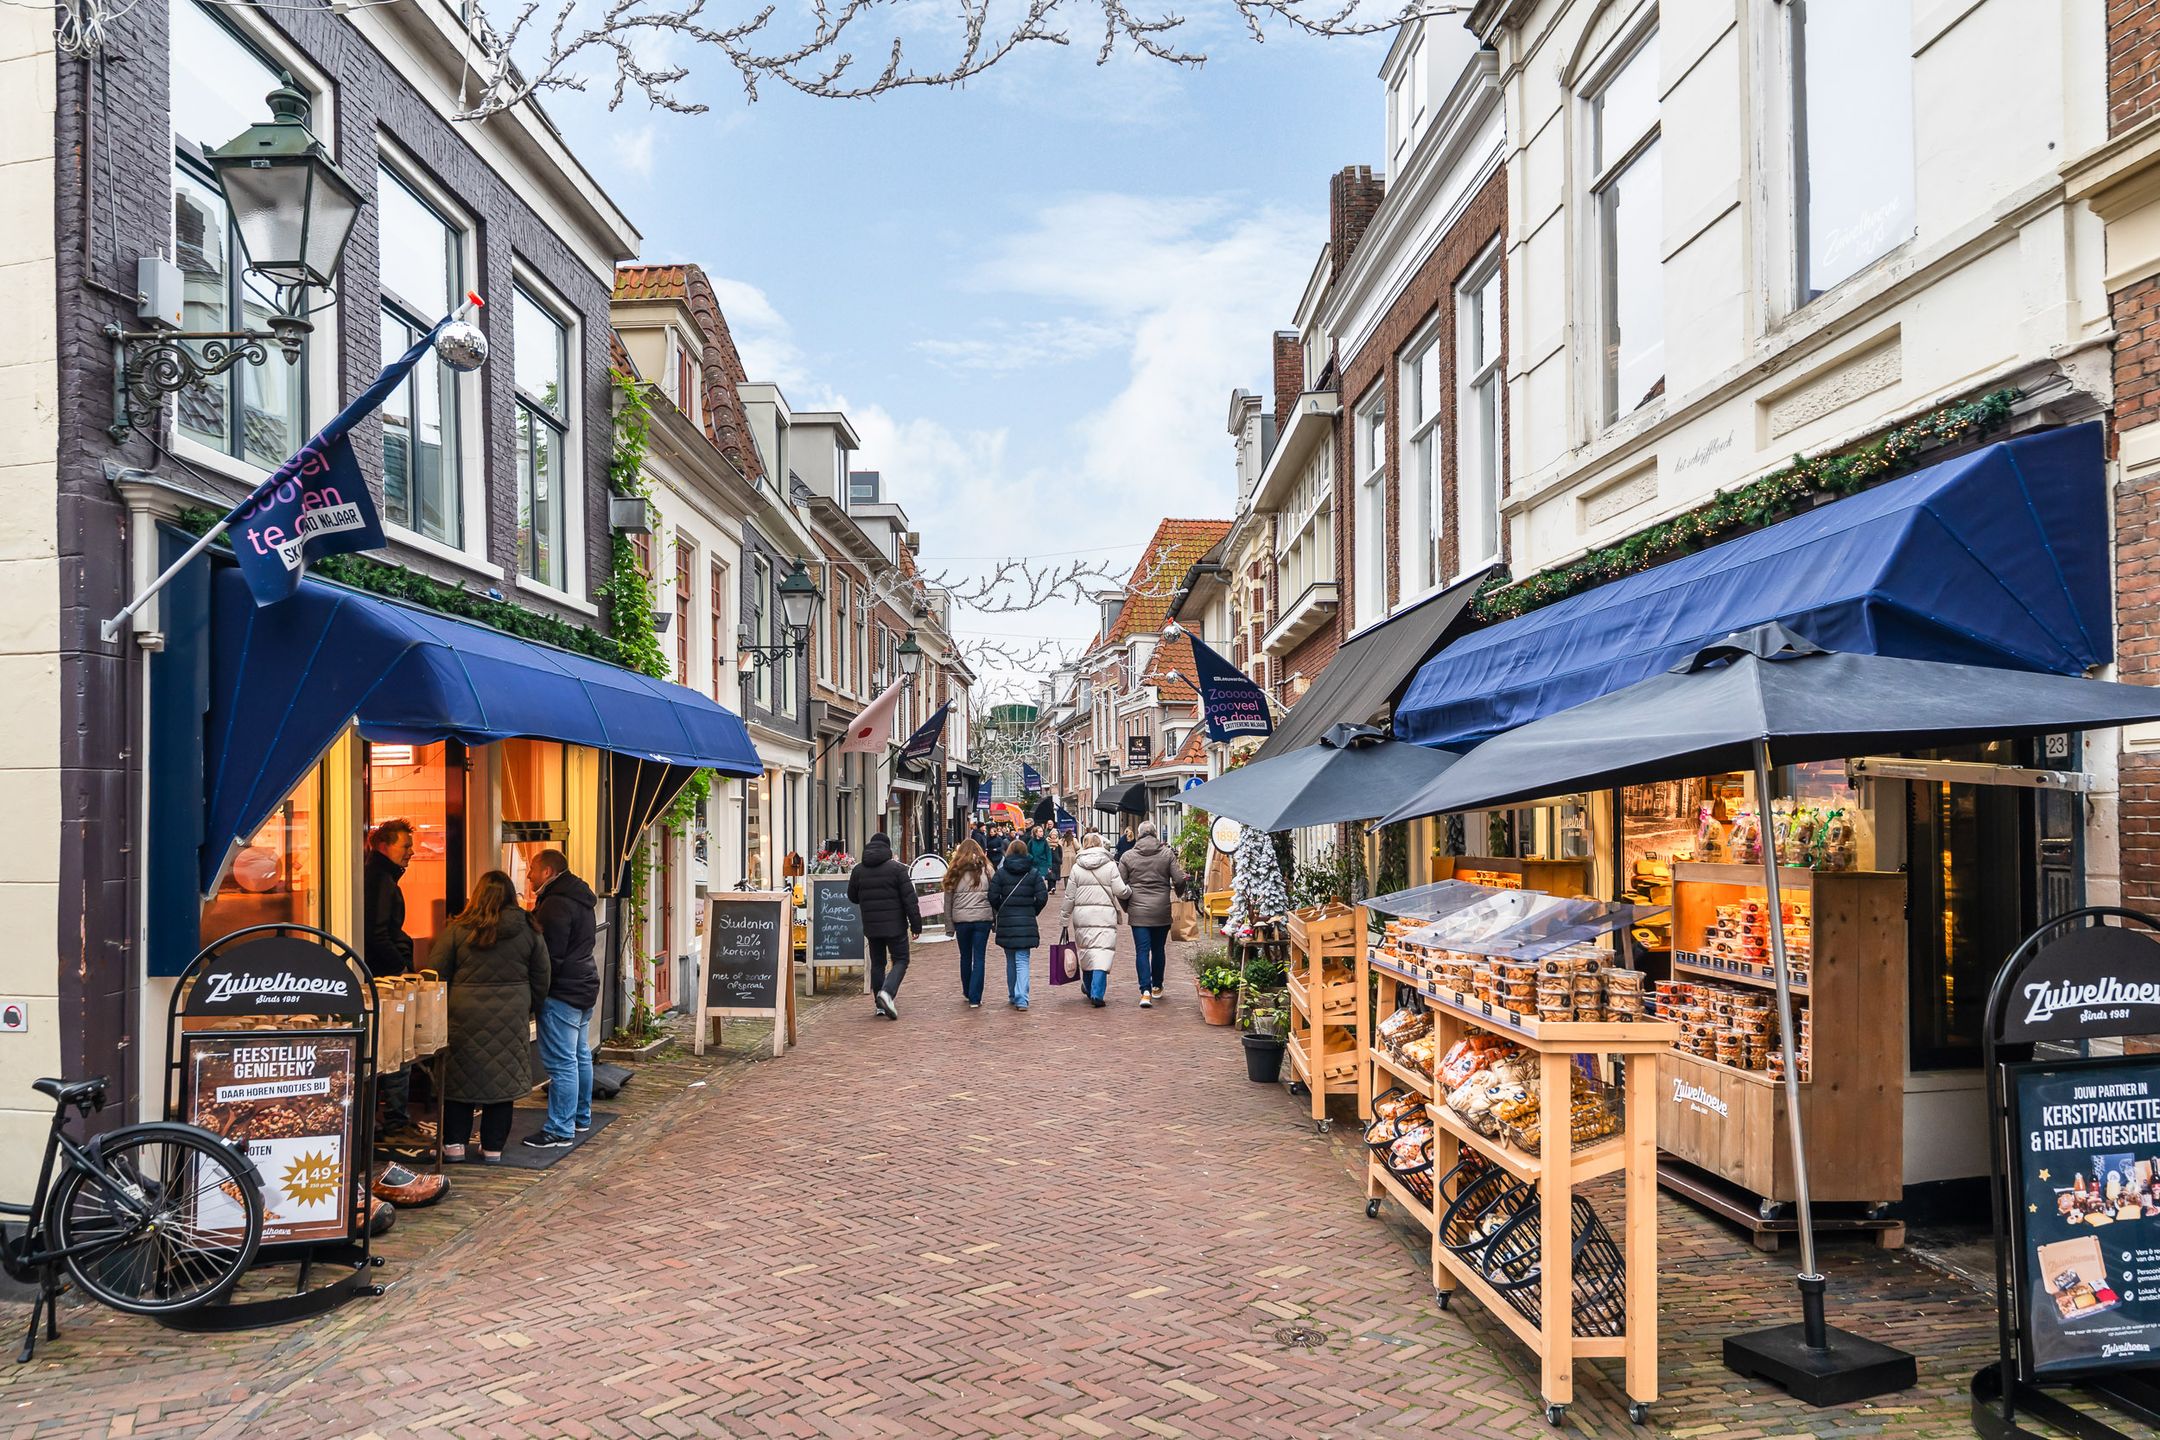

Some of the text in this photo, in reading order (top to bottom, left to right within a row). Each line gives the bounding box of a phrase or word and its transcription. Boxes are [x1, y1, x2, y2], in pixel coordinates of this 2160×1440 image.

[318, 509, 359, 528] NAJAAR
[247, 526, 288, 555] te
[1214, 711, 1261, 726] te doen
[2049, 737, 2064, 753] 23
[821, 903, 851, 914] Kapper
[720, 914, 774, 929] Studenten
[736, 934, 761, 946] 20%
[732, 972, 743, 980] of
[205, 972, 349, 1003] Zuivelhoeve
[727, 981, 764, 991] afspraak
[256, 994, 300, 1004] Sinds 1981
[2080, 1009, 2130, 1023] Sinds 1981
[233, 1046, 318, 1063] FEESTELIJK
[234, 1061, 316, 1079] GENIETEN?
[221, 1081, 326, 1099] DAAR HOREN NOOTJES BIJ
[2073, 1082, 2148, 1100] JOUW PARTNER IN
[1673, 1078, 1729, 1119] Zuivelhoeve
[2042, 1098, 2160, 1126] KERSTPAKKETTE
[2030, 1131, 2042, 1152] &
[2102, 1342, 2151, 1358] Zuivelhoeve
